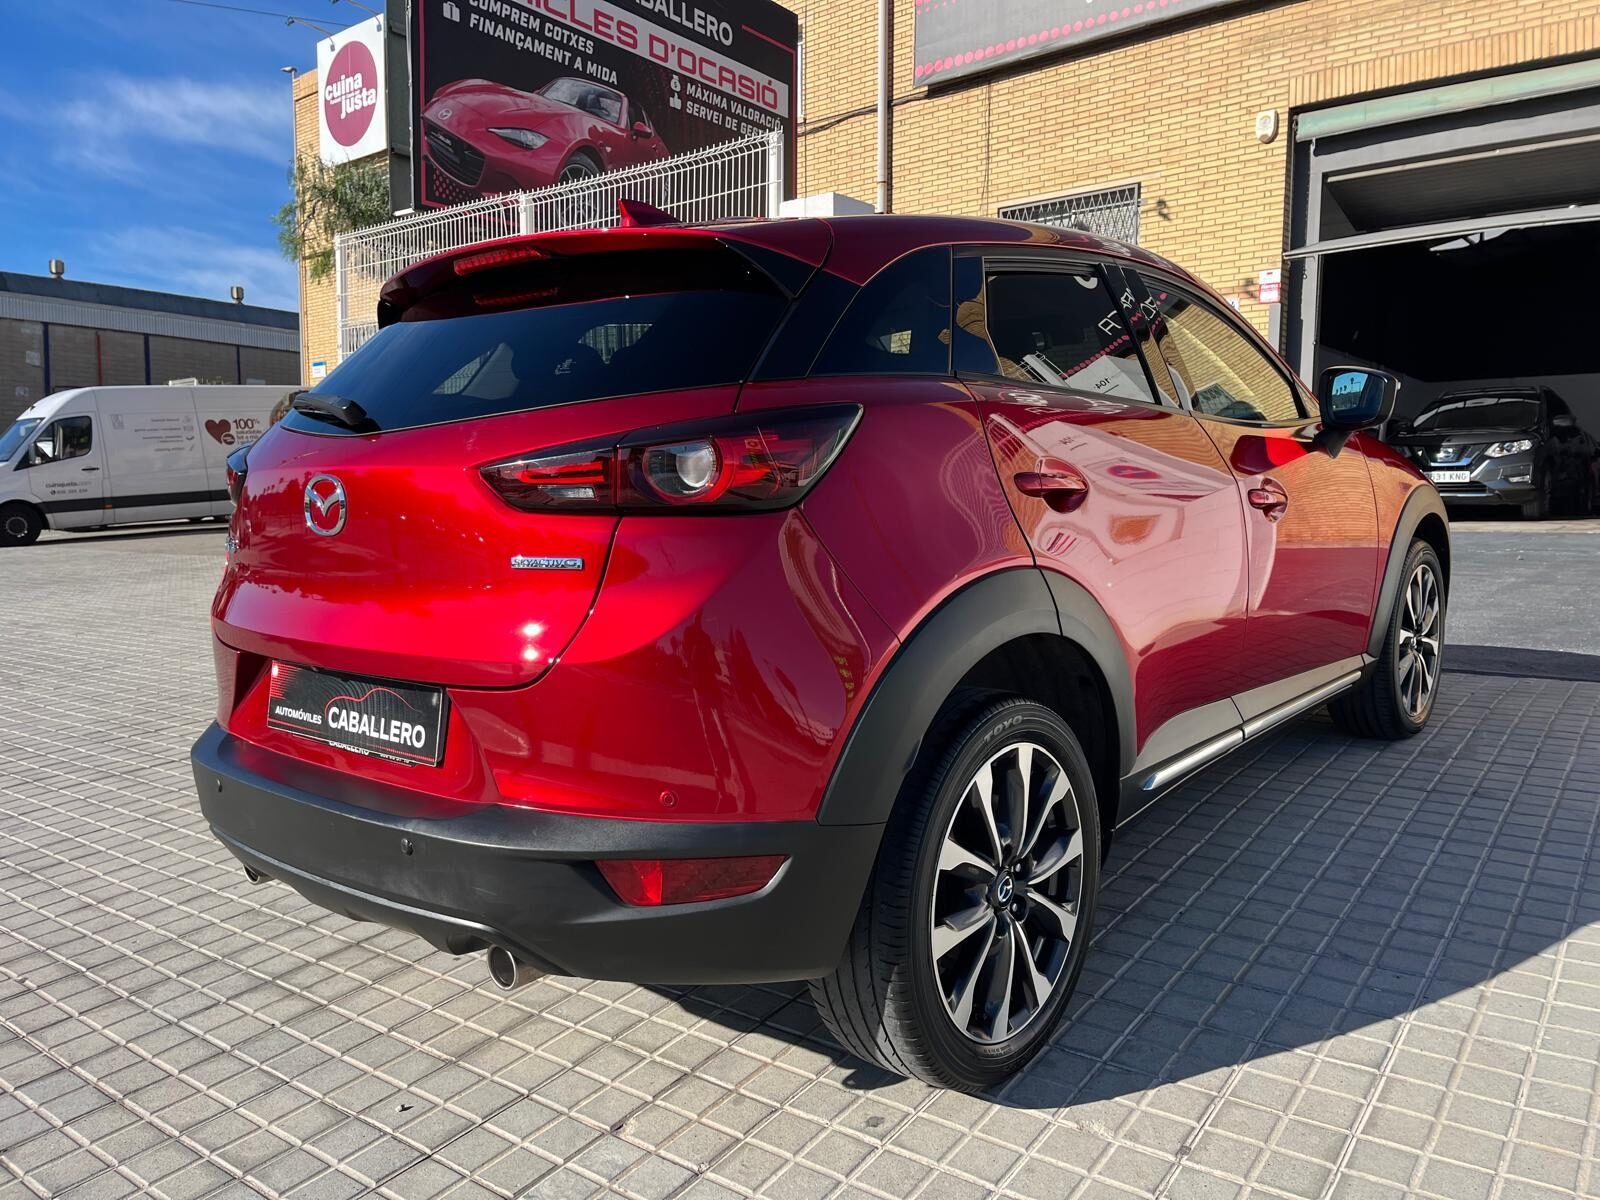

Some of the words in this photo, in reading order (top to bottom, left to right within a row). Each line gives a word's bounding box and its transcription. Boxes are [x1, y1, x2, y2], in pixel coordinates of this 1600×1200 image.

[469, 13, 572, 66] FINANÇAMENT
[573, 56, 583, 71] A
[586, 61, 618, 86] MIDA
[544, 22, 594, 55] COTXES
[325, 72, 363, 101] cuina
[648, 33, 778, 110] D'OCASIÓ
[340, 87, 377, 120] justa
[686, 82, 728, 111] MÀXIMA
[730, 100, 781, 131] VALORACIÓ
[686, 101, 723, 126] SERVEI
[725, 115, 738, 131] DE
[231, 417, 260, 430] 100%
[275, 706, 322, 725] AUTOMÓVILES
[328, 706, 426, 749] CABALLERO
[983, 715, 1023, 744] TOYO
